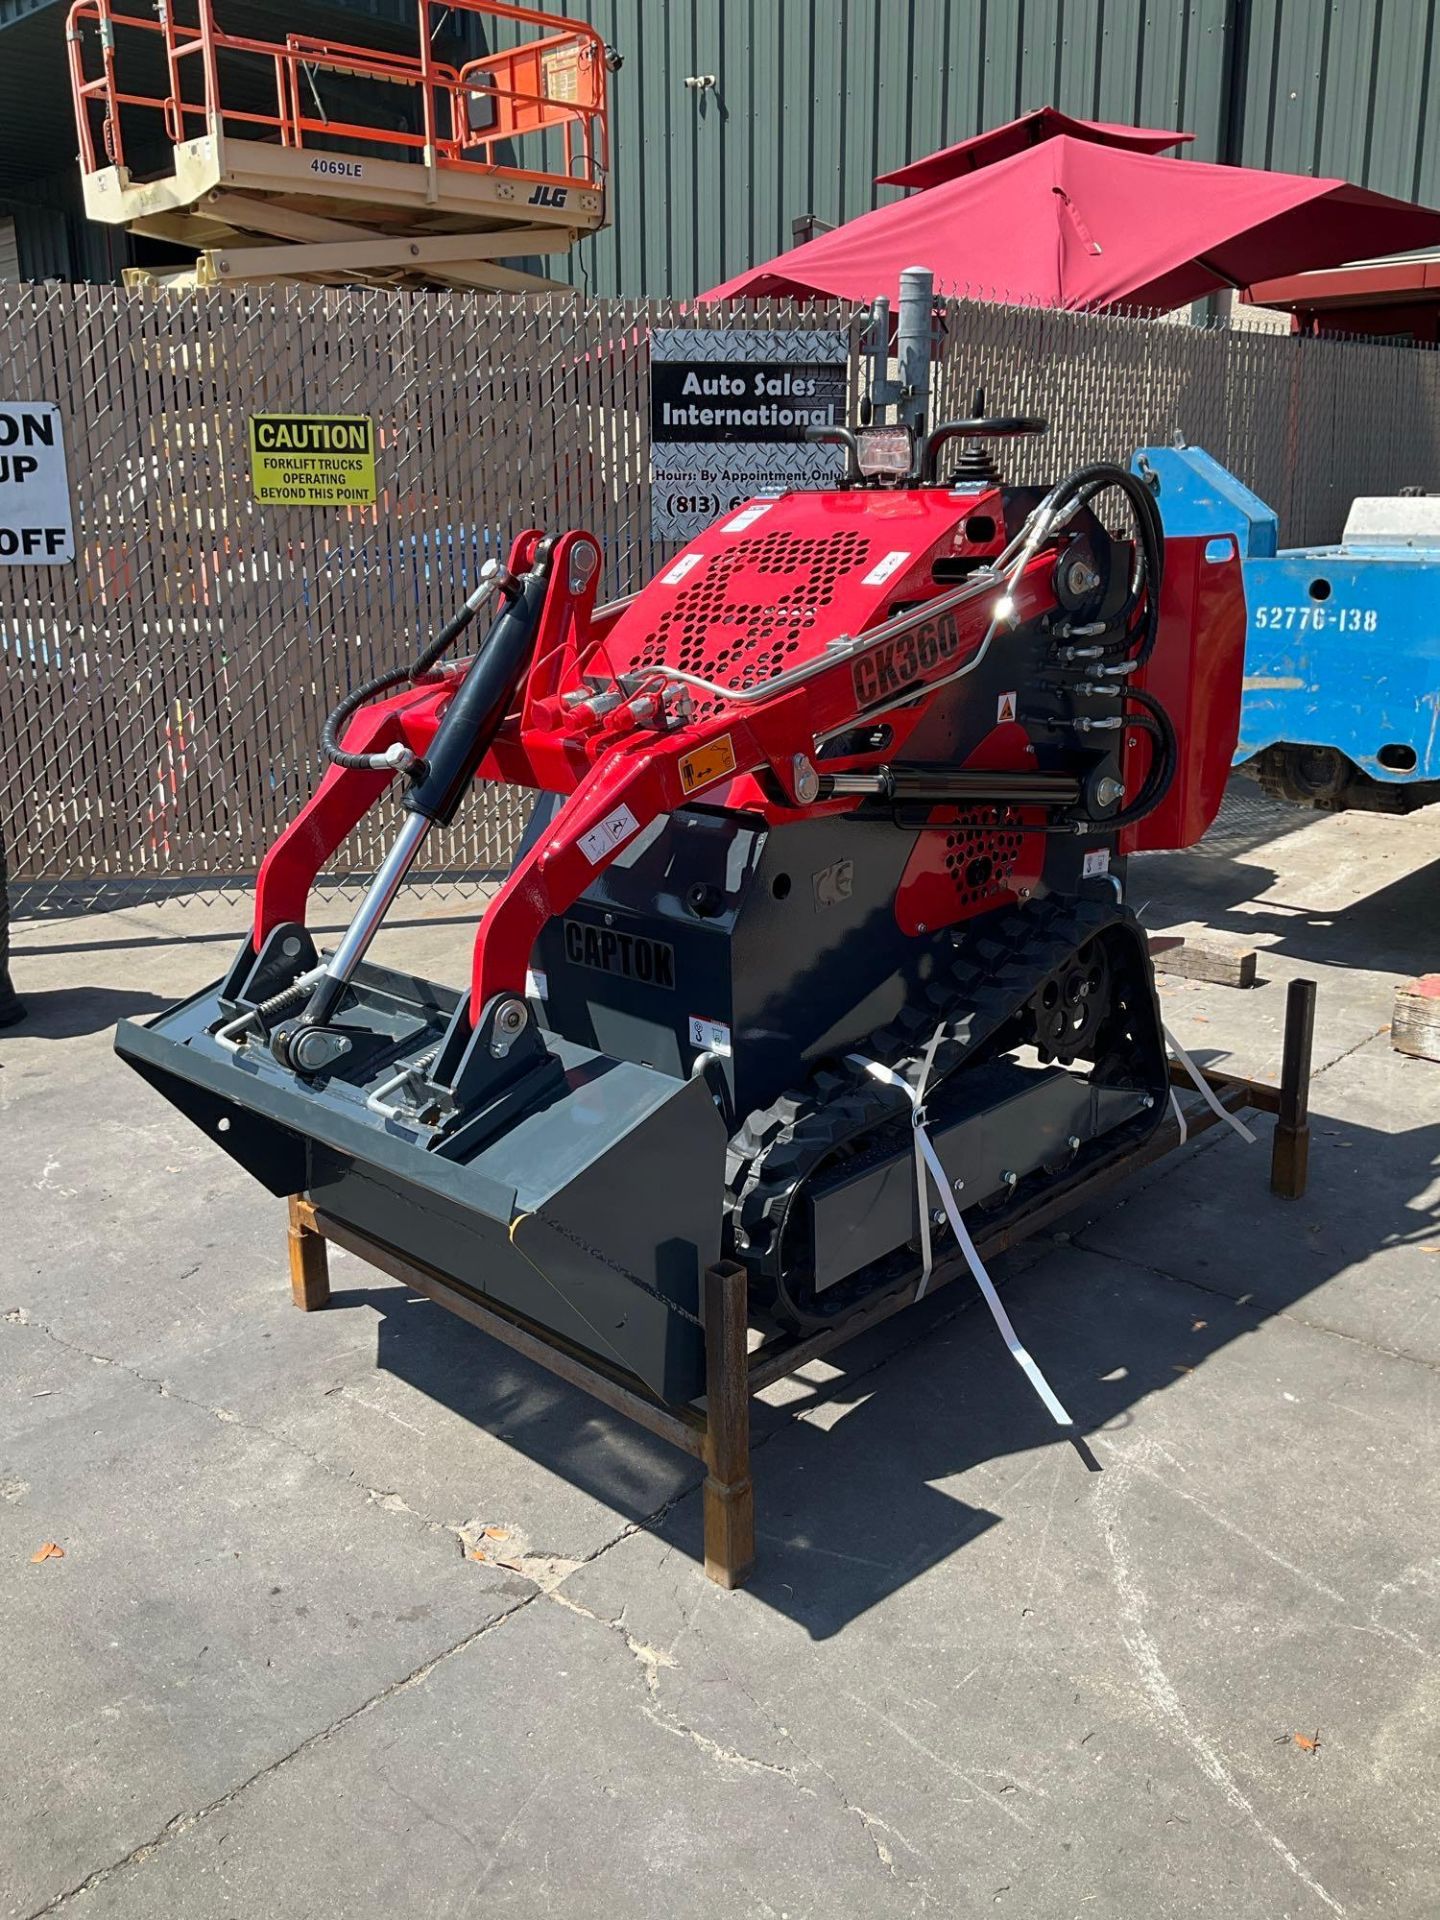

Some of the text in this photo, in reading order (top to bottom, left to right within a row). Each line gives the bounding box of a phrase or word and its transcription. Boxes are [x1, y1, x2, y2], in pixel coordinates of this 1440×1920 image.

[310, 159, 362, 177] 4069LE
[528, 186, 568, 208] JLG
[682, 372, 817, 397] Auto Sales
[663, 403, 835, 426] International
[258, 423, 366, 449] CAUTION
[263, 458, 363, 471] FORKLIFT TRUCKS
[283, 473, 346, 485] OPERATING
[656, 470, 842, 483] Hours: By Appointment Only
[261, 487, 369, 500] BEYOND THIS POINT
[666, 493, 720, 517] (813)
[1255, 607, 1378, 632] 52776-138
[853, 613, 959, 705] CK360
[565, 922, 675, 990] CAPTOK
